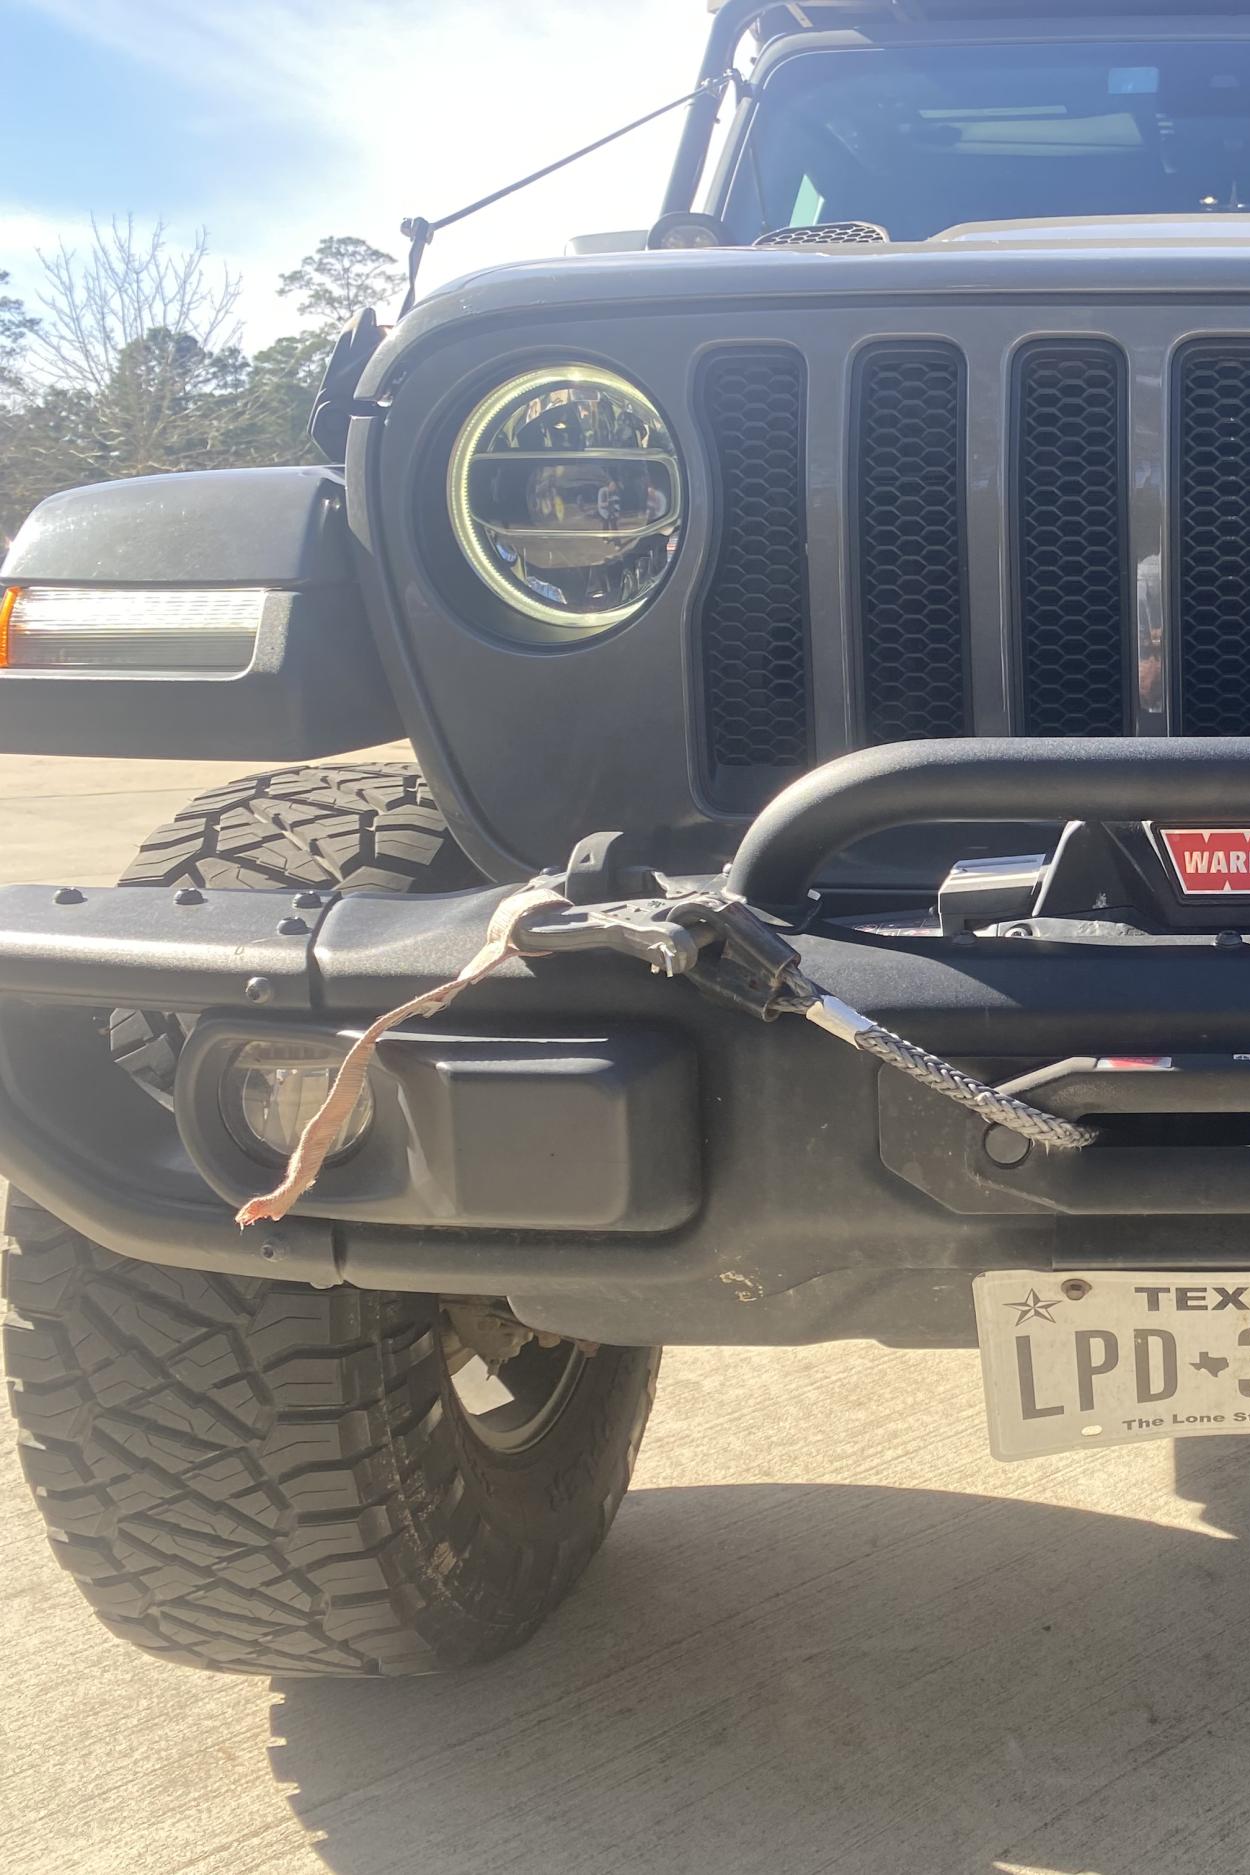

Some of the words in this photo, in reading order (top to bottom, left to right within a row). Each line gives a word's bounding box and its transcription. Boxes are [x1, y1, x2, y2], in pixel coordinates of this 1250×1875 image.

[1015, 1327, 1178, 1421] LPD
[1122, 1418, 1164, 1431] The
[1172, 1413, 1225, 1424] Lone
